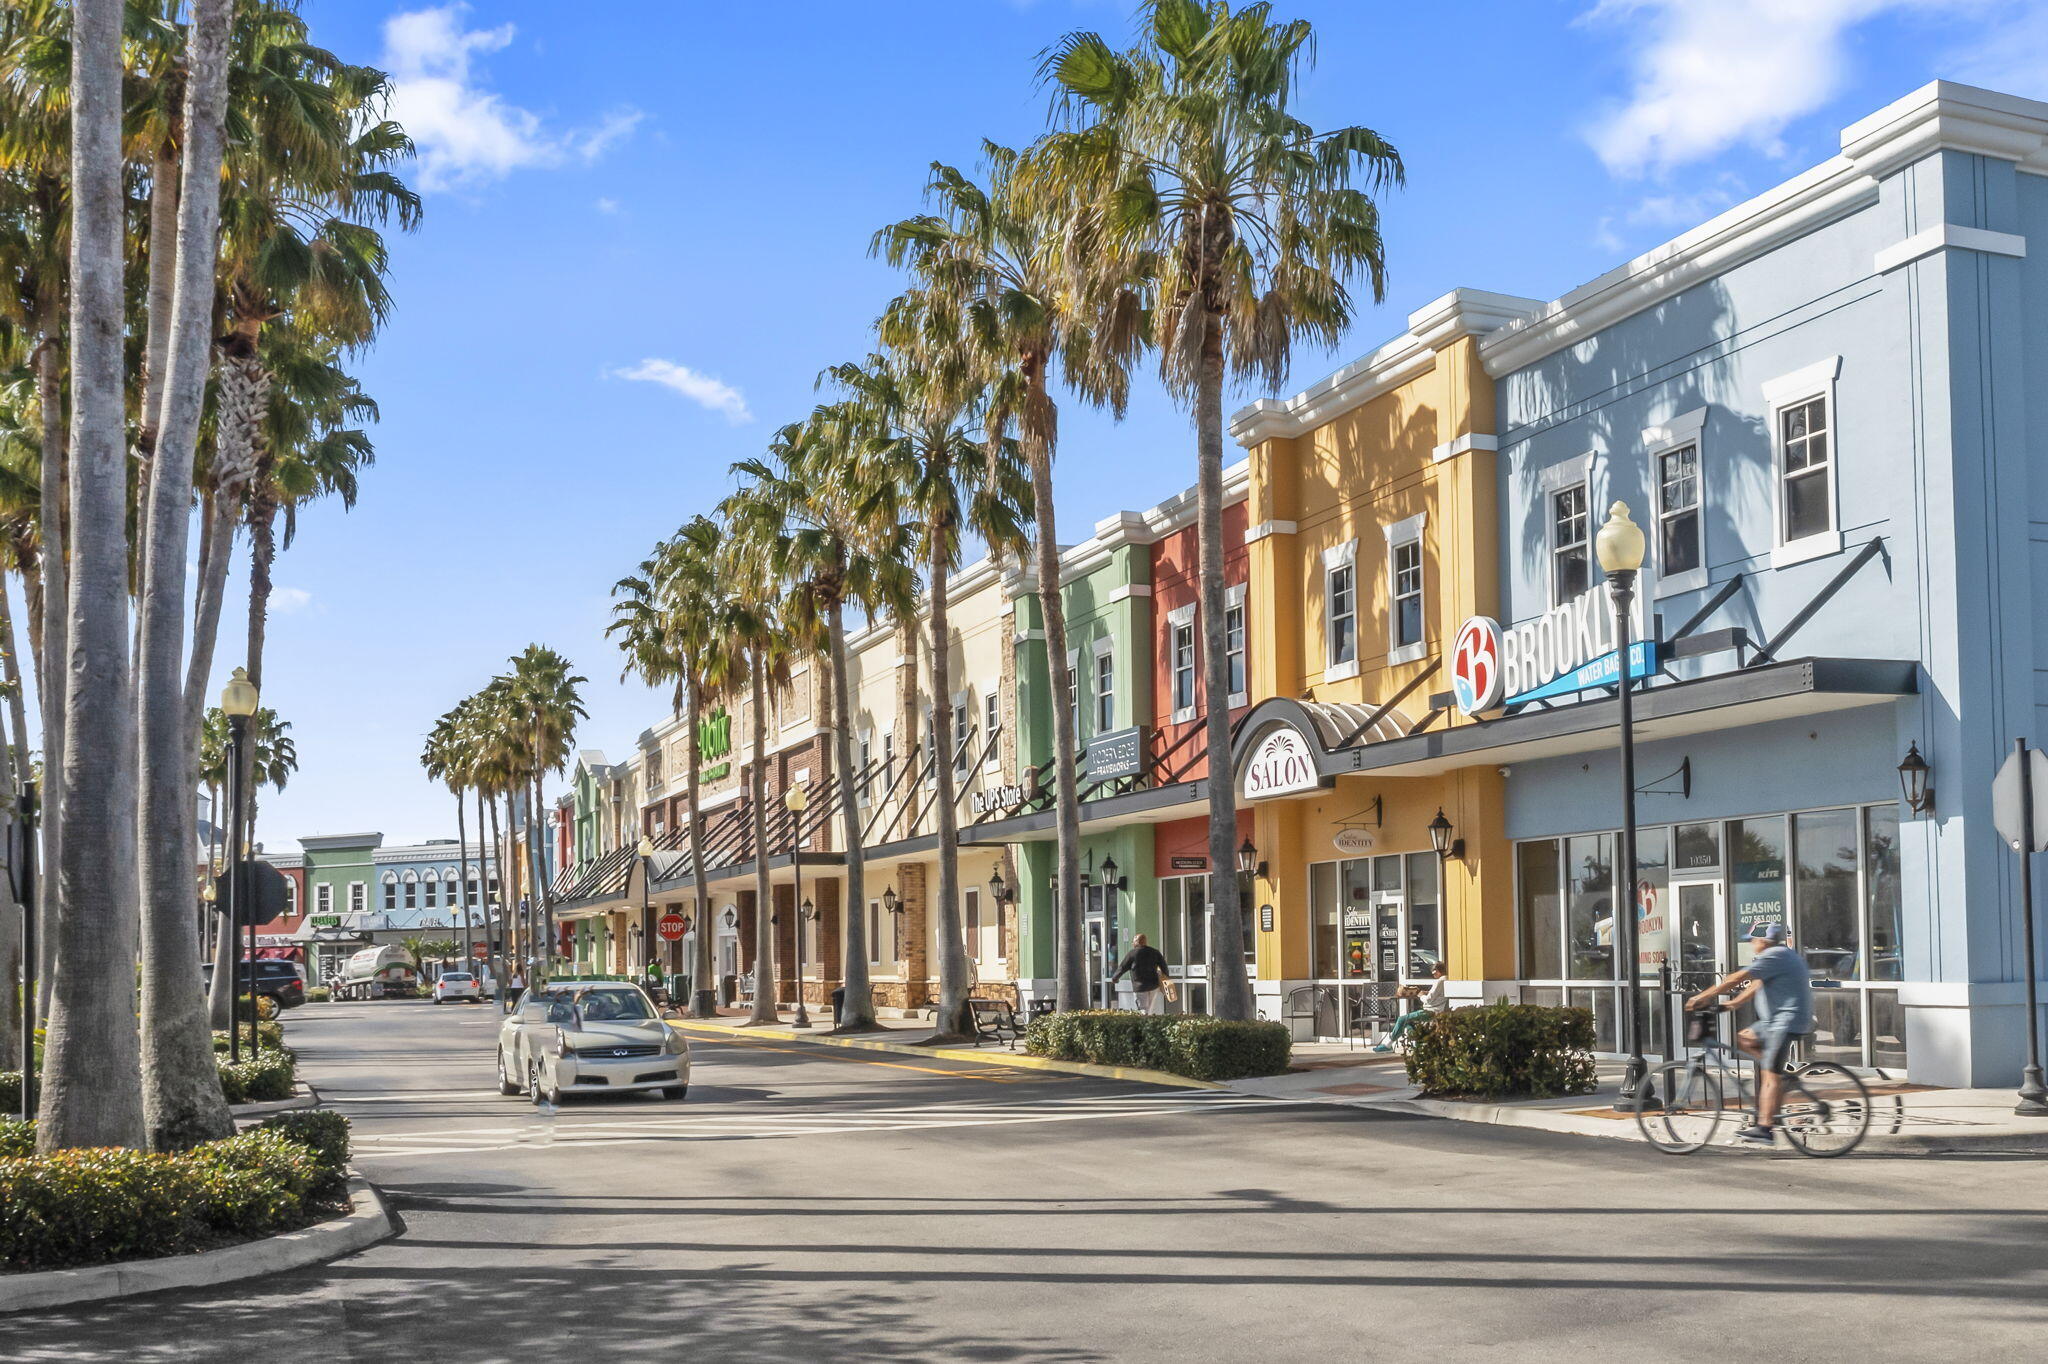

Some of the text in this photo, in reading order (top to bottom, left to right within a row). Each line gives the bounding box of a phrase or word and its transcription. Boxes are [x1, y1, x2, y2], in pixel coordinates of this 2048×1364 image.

[1577, 646, 1644, 687] WATER BAG CO.
[1091, 741, 1135, 764] MODERN EDGE
[1096, 760, 1130, 776] FRAMEWORKS
[1251, 754, 1310, 792] SALON
[971, 786, 1021, 813] The UPS Store
[1338, 839, 1373, 847] IDENTITY
[1690, 855, 1712, 866] 10350
[1758, 868, 1780, 879] KITE
[1740, 901, 1781, 915] LEASING
[1740, 913, 1782, 924] 407 563 0100
[660, 922, 684, 932] STOP
